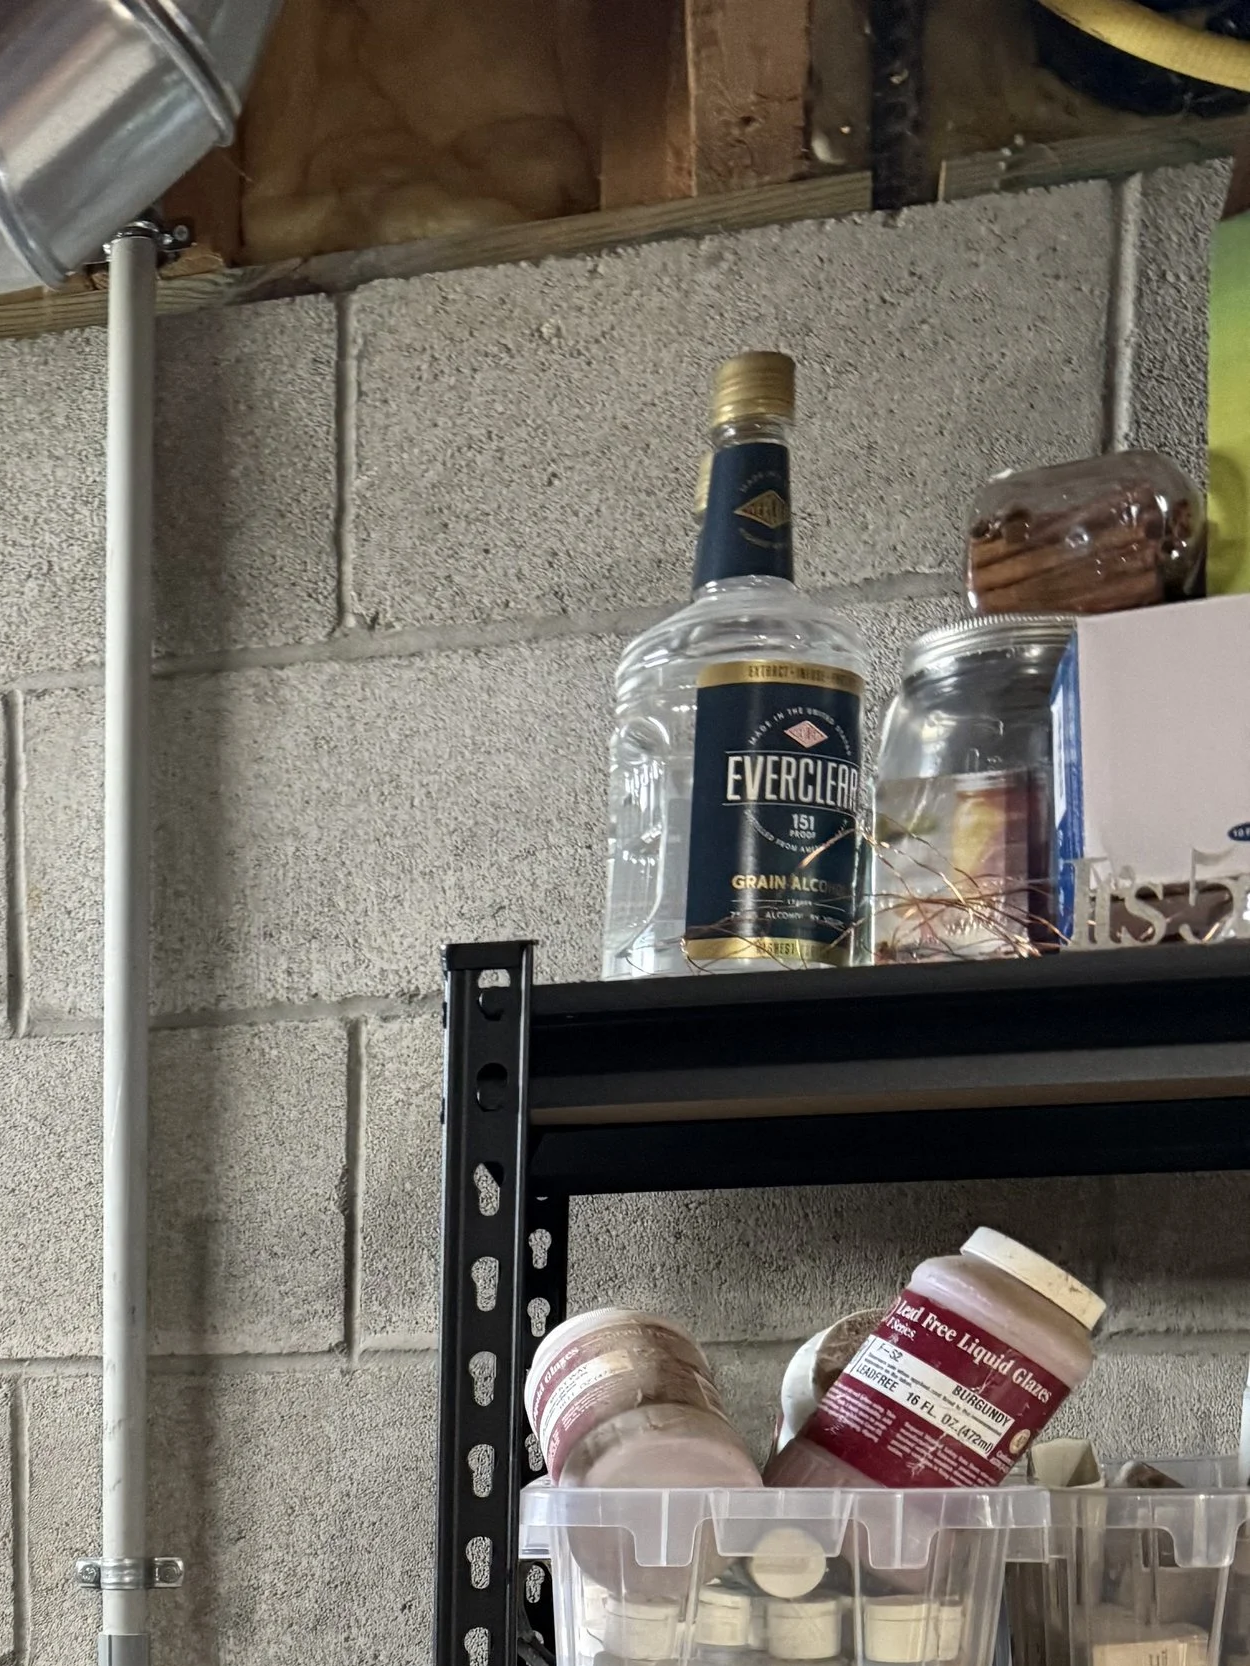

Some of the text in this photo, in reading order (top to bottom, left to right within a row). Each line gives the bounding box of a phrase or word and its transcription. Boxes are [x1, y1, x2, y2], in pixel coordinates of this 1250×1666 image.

[749, 720, 772, 746] MADE
[774, 712, 785, 723] IN
[787, 706, 804, 717] THE
[726, 754, 859, 814] EVERCLEAR
[789, 828, 817, 840] PROOF
[791, 812, 816, 830] 151
[731, 874, 787, 890] GRAIN
[544, 1346, 580, 1383] Glazes
[896, 1300, 1053, 1404] Lead Free Liquid Glazes
[855, 1361, 900, 1393] LEADFREE
[906, 1390, 919, 1406] 16
[920, 1400, 938, 1419] FL.
[951, 1385, 1012, 1428] BURGUNDY
